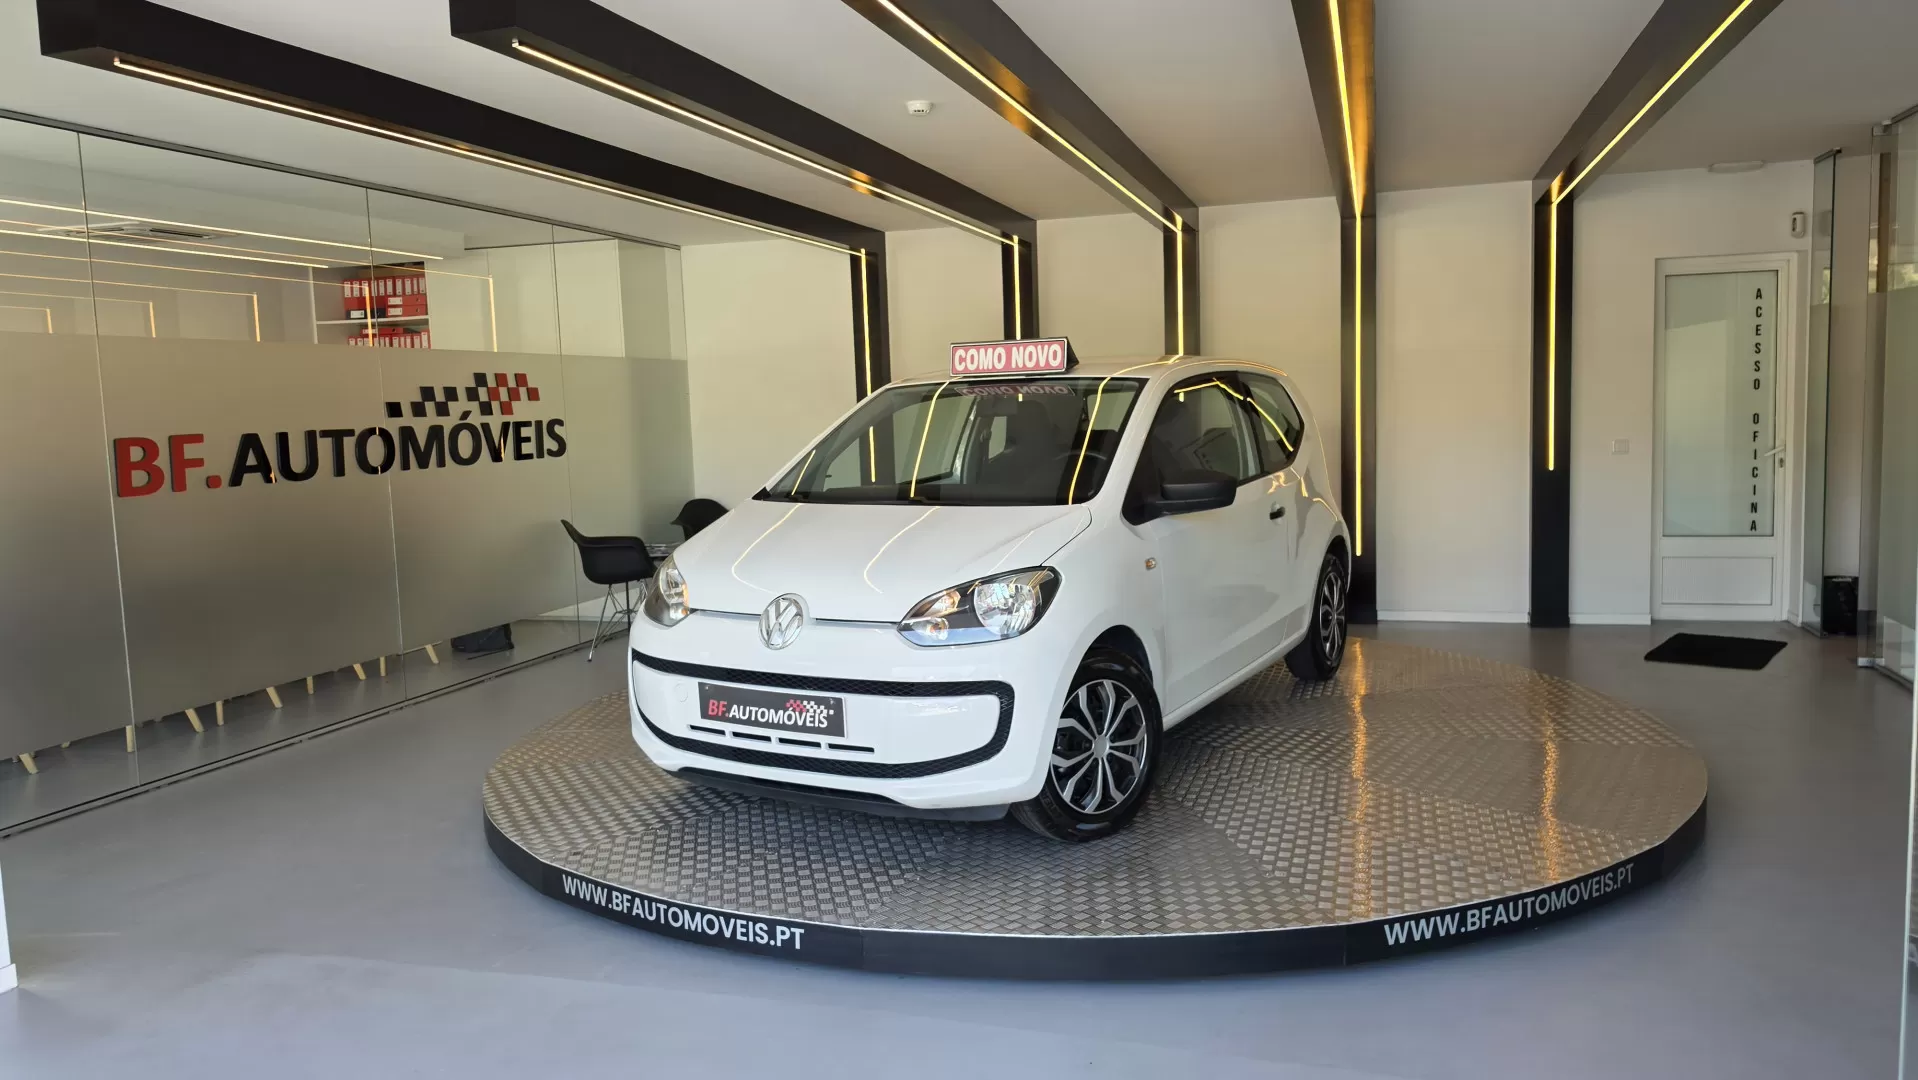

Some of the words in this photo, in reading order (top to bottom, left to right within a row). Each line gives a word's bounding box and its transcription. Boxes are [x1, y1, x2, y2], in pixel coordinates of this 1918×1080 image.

[954, 347, 1006, 371] COMO
[1011, 344, 1062, 368] NOVO
[1753, 288, 1763, 390] ACESSO
[1750, 413, 1760, 532] OFICINA
[562, 874, 804, 950] WWW.BFAUTOMOVEIS.PT
[1384, 863, 1634, 946] WWW.BFAUTOMOVEIS.PT
